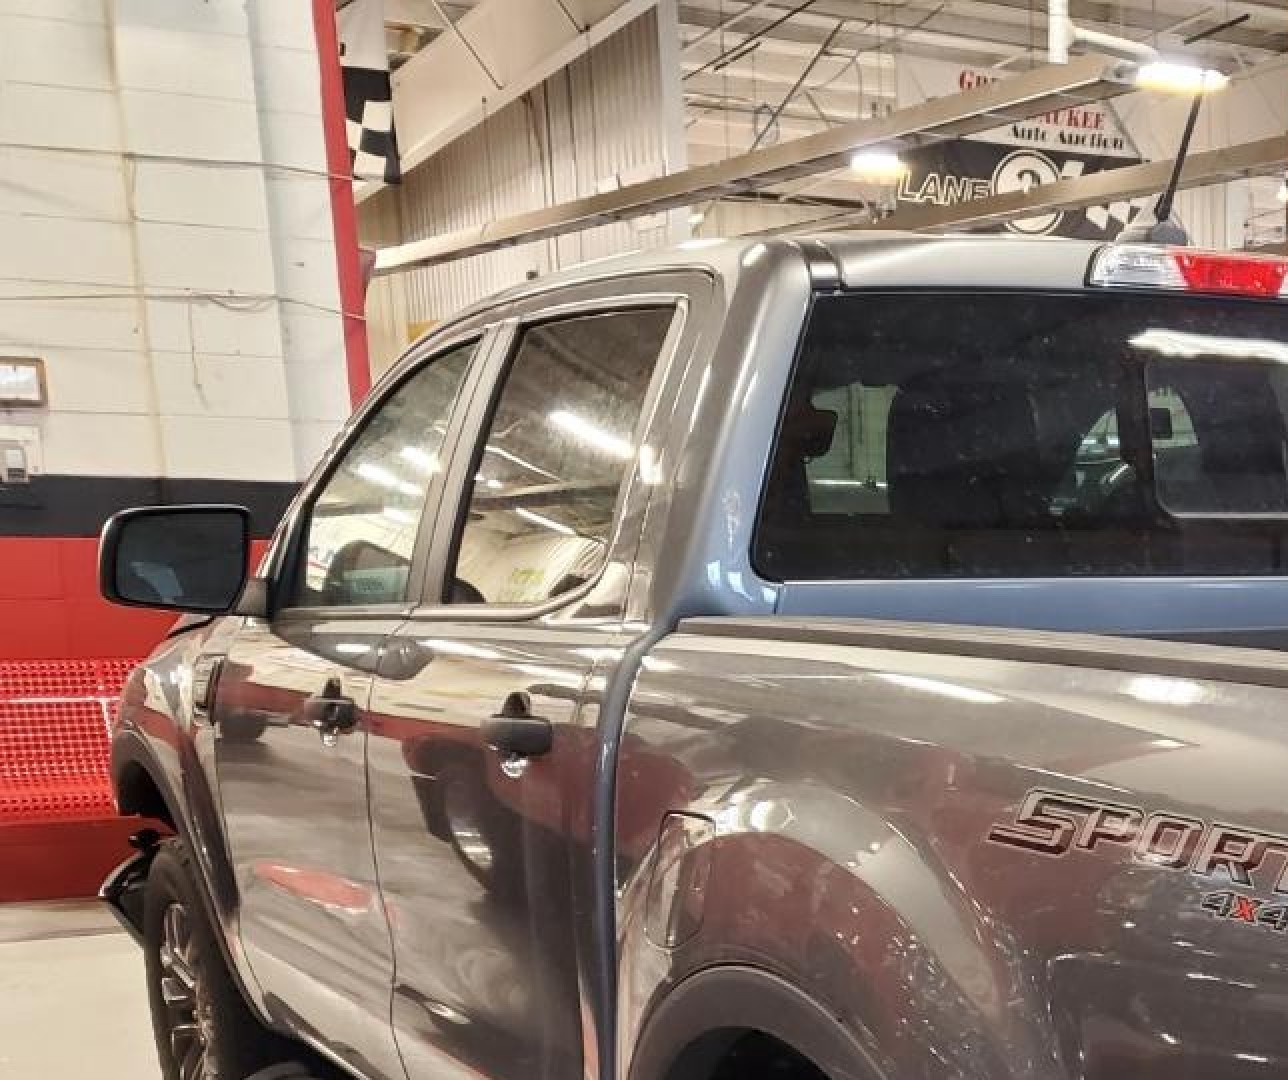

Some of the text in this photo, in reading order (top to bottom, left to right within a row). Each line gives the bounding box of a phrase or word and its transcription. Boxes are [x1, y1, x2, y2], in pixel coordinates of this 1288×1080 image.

[1007, 123, 1124, 150] Auto Auction
[898, 168, 992, 206] LANE
